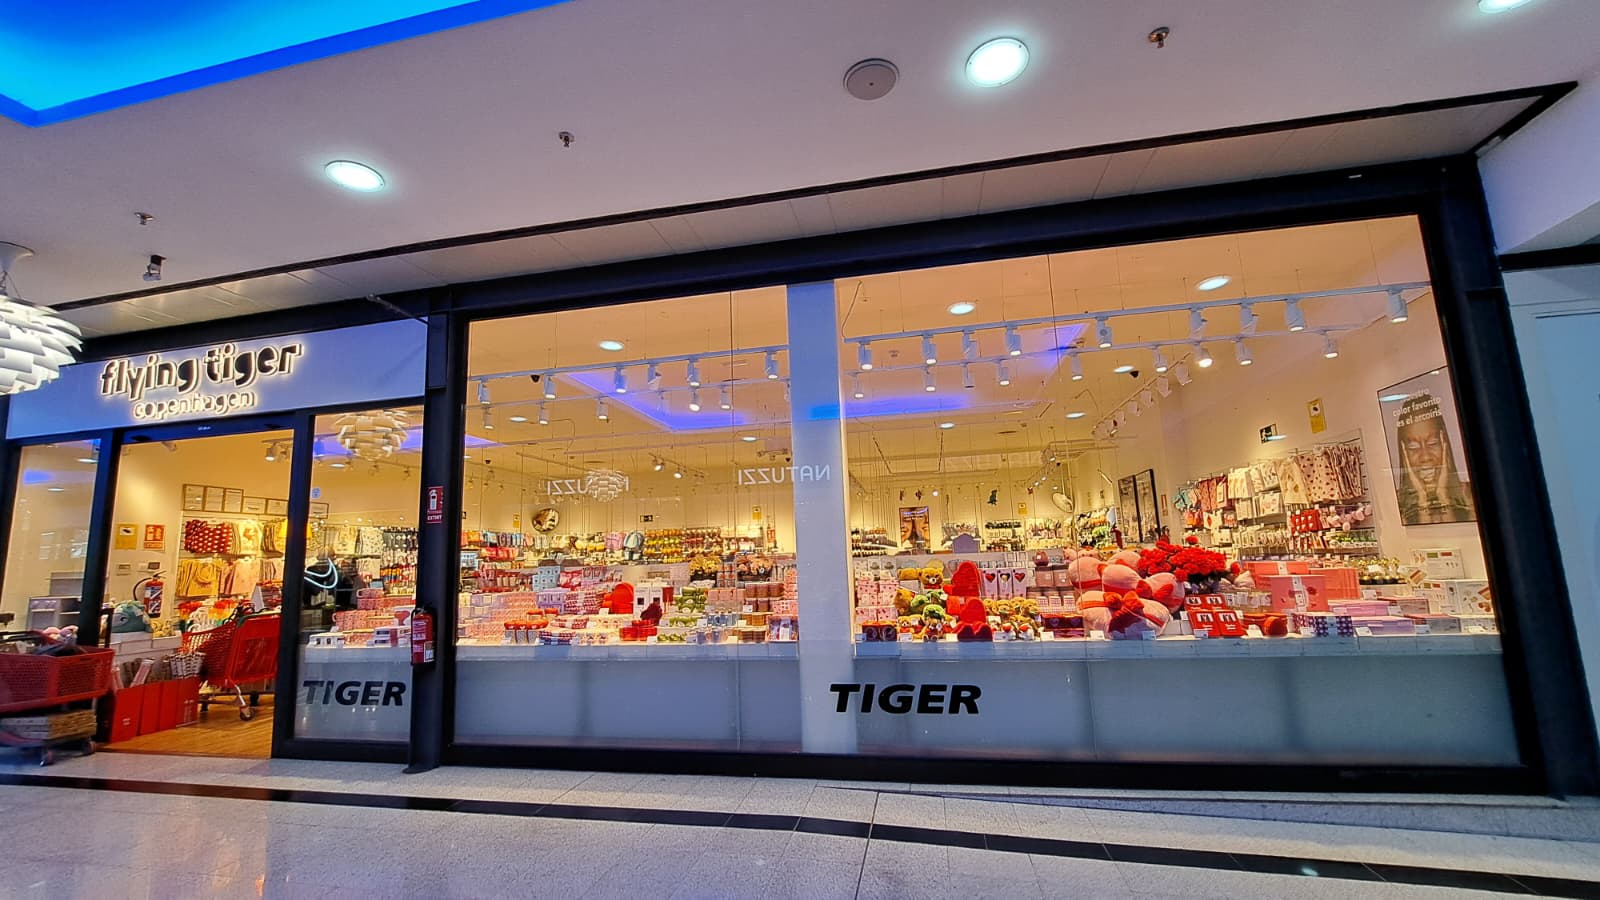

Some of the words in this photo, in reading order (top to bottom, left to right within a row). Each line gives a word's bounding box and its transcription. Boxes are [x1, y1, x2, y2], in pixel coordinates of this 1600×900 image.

[101, 354, 199, 400] flying
[204, 343, 304, 386] tiger
[134, 391, 256, 420] copenhagen
[303, 680, 407, 706] TIGER
[829, 683, 982, 714] TIGER
